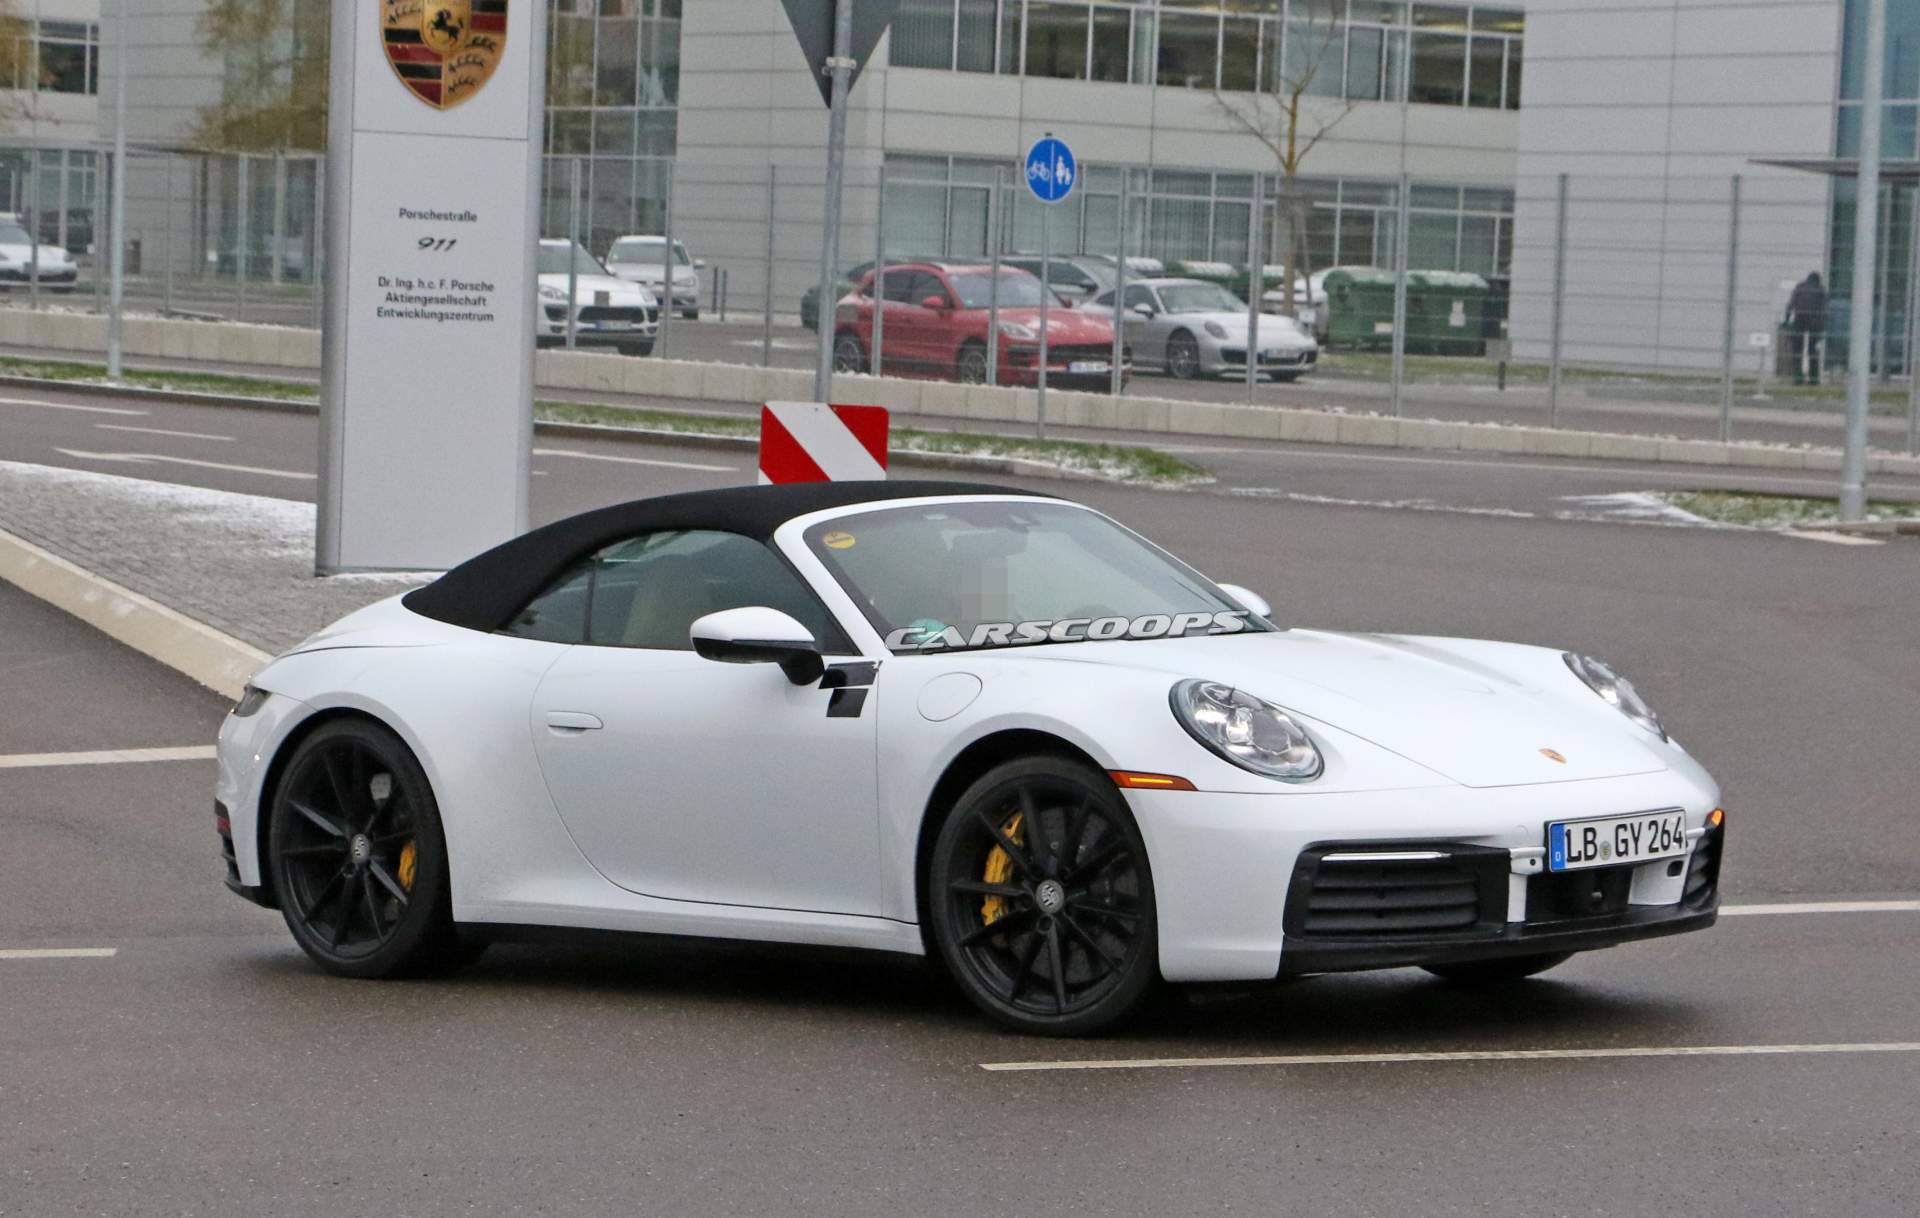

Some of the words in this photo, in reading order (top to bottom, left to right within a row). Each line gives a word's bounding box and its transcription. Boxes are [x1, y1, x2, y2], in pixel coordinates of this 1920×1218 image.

[399, 207, 478, 222] Porschestraße
[418, 237, 457, 251] 911
[378, 276, 393, 288] Dr.
[395, 277, 415, 291] Ing.
[439, 279, 448, 290] F.
[451, 280, 495, 292] Porsche
[385, 292, 487, 307] Aktiengesellschaft
[376, 306, 495, 322] Entwicklungszentrum
[1565, 827, 1598, 863] LB
[1615, 821, 1643, 858] GY
[1648, 816, 1684, 854] 264
